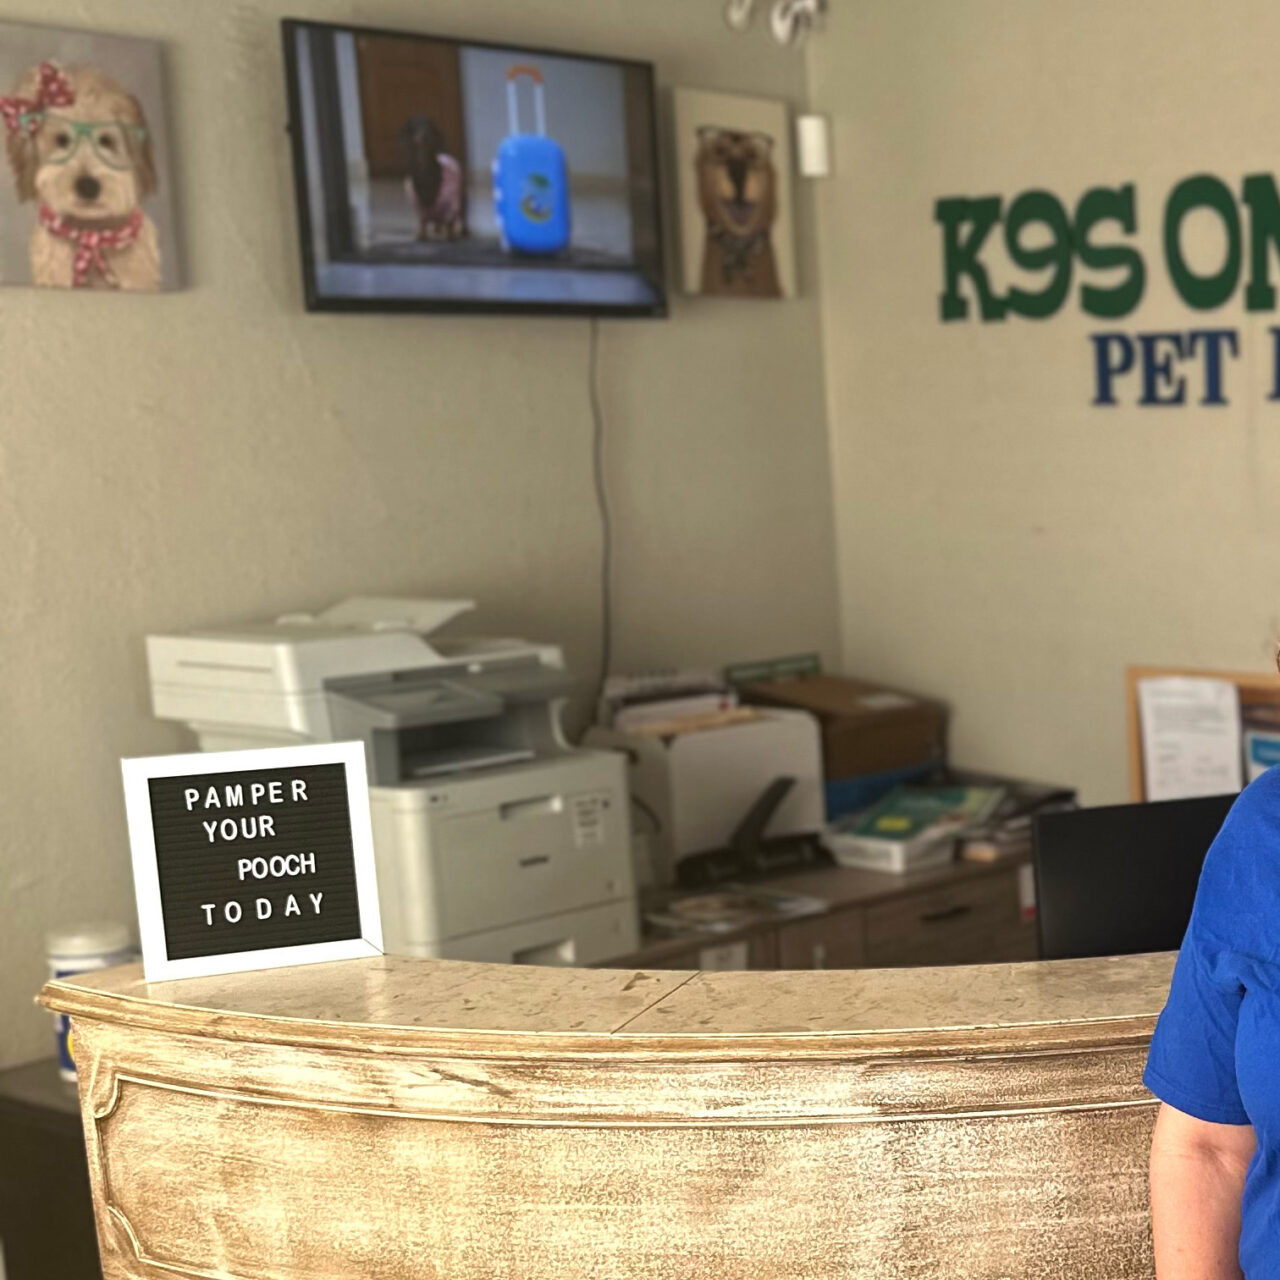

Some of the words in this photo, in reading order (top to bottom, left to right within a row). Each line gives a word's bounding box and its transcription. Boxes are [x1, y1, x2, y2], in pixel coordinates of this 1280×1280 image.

[934, 182, 1147, 322] K9S
[1090, 329, 1238, 407] PET
[184, 779, 308, 811] PAMPER
[203, 815, 276, 843] YOUR
[238, 853, 316, 881] POOCH
[200, 892, 324, 926] TODAY
